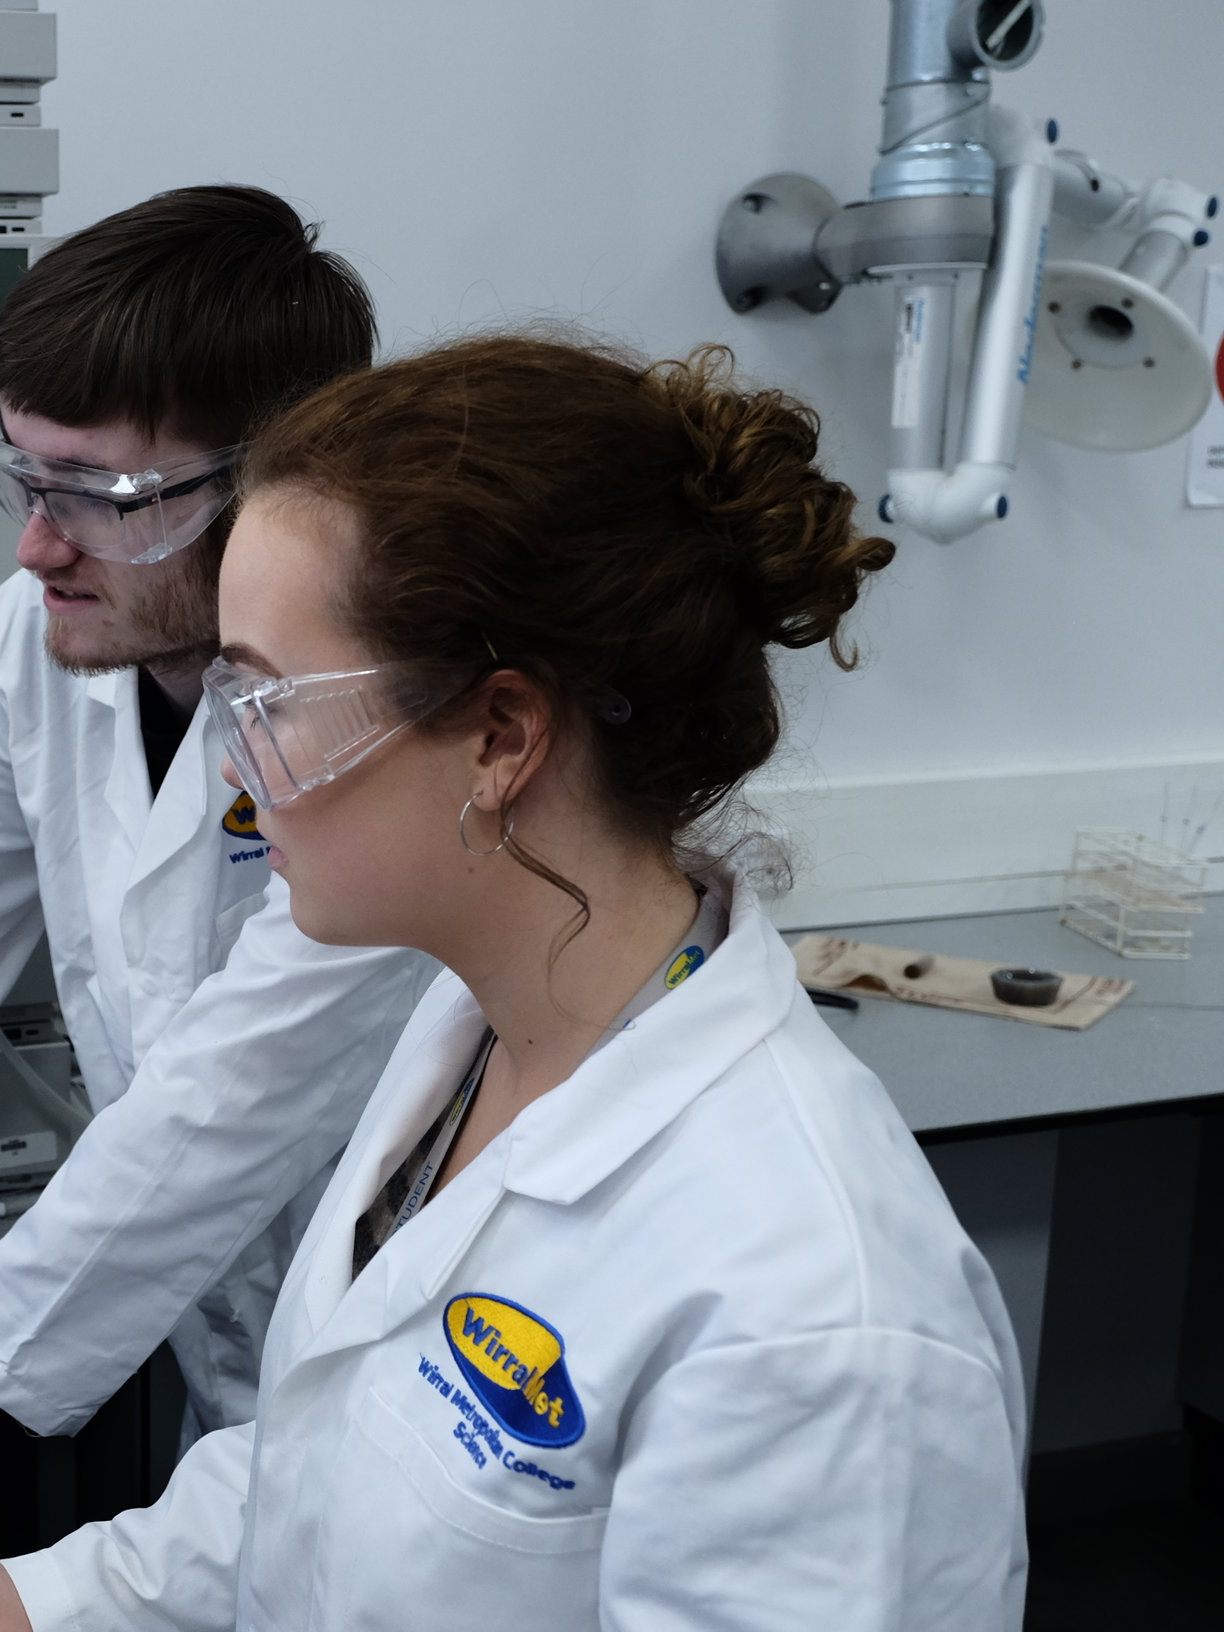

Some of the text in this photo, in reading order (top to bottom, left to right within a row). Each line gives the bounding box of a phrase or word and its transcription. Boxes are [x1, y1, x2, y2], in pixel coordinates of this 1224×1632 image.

[229, 847, 264, 864] Wirral
[393, 1161, 434, 1235] TUDENT
[418, 1356, 454, 1398] Wirral
[502, 1450, 576, 1490] College
